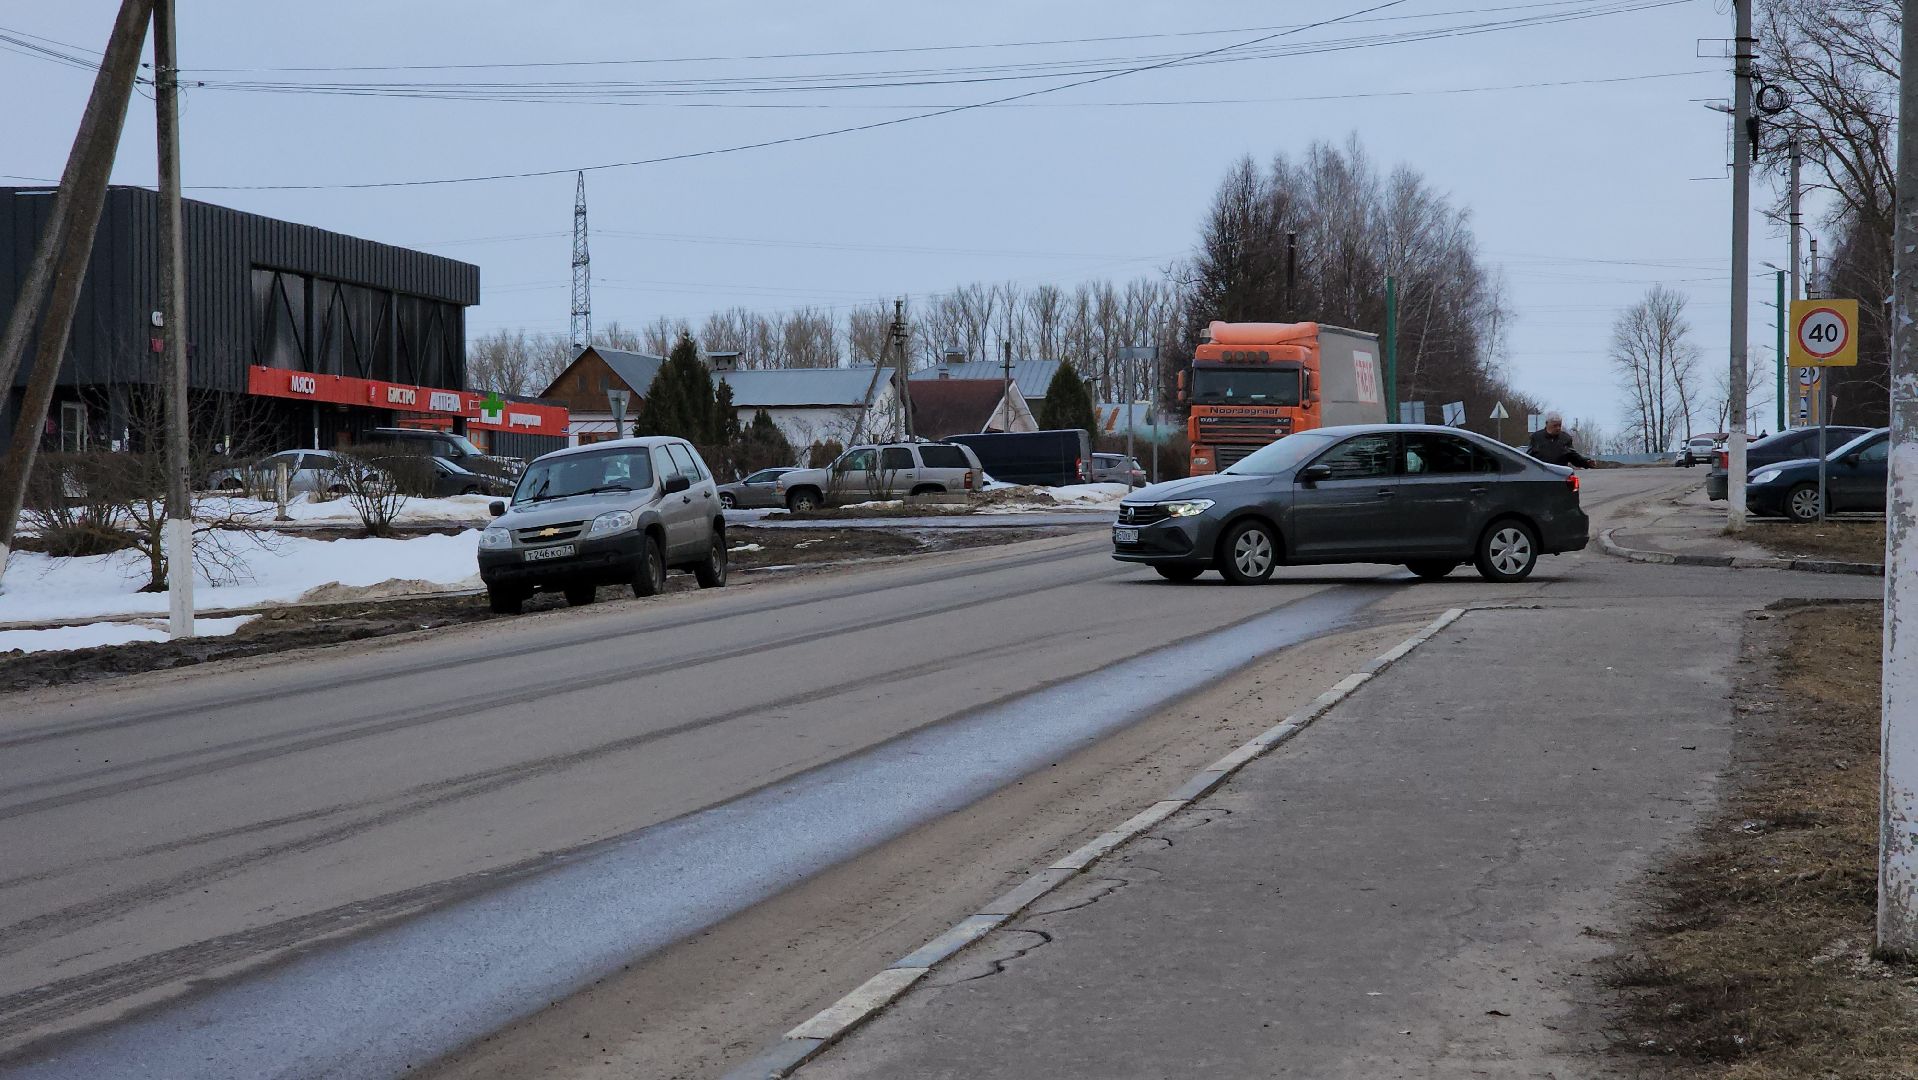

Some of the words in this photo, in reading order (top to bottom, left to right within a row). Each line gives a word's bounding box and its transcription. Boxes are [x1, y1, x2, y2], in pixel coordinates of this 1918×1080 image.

[1808, 323, 1838, 342] 40
[291, 375, 315, 394] МЯСО
[387, 386, 416, 405] БИСТРО
